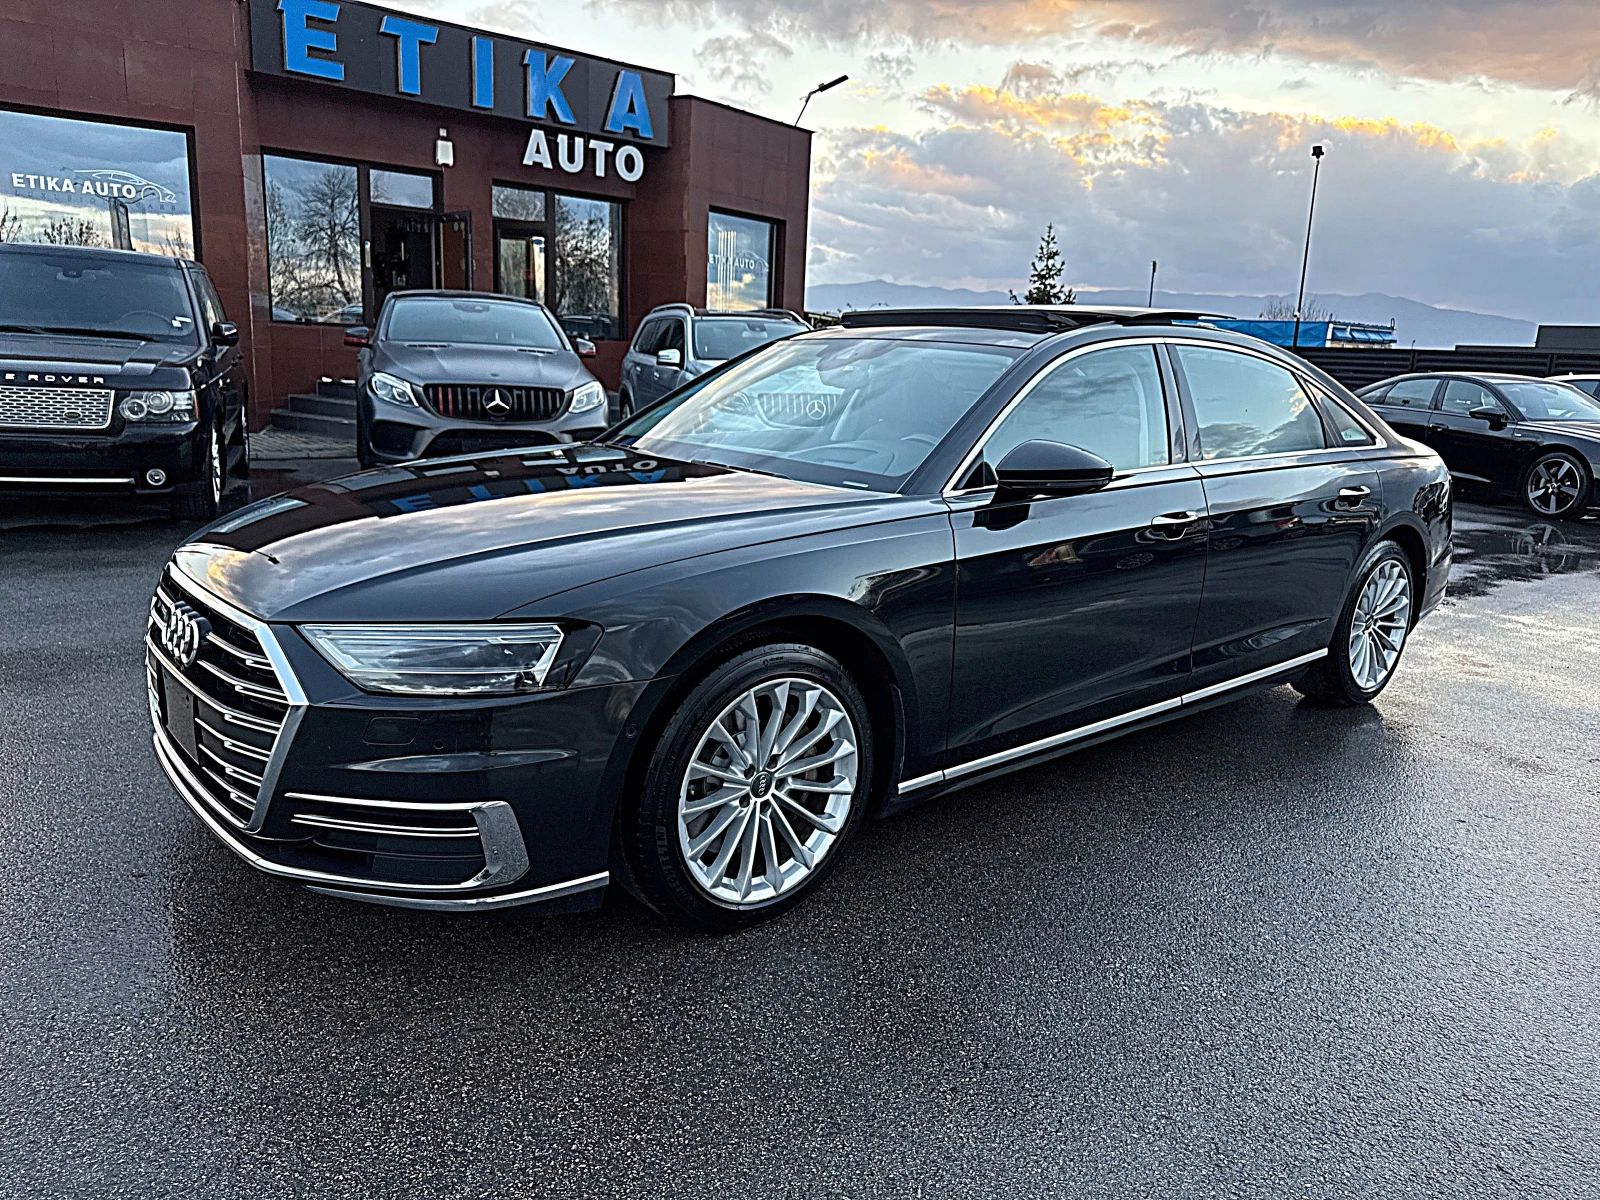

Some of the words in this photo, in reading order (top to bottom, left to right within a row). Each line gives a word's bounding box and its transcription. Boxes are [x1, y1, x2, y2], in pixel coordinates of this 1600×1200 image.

[277, 0, 654, 139] ETIKA
[522, 128, 645, 182] AUTO
[12, 173, 75, 193] ETIKA
[82, 180, 137, 199] AUTO
[734, 257, 755, 270] AUTO
[27, 374, 104, 384] ROVER
